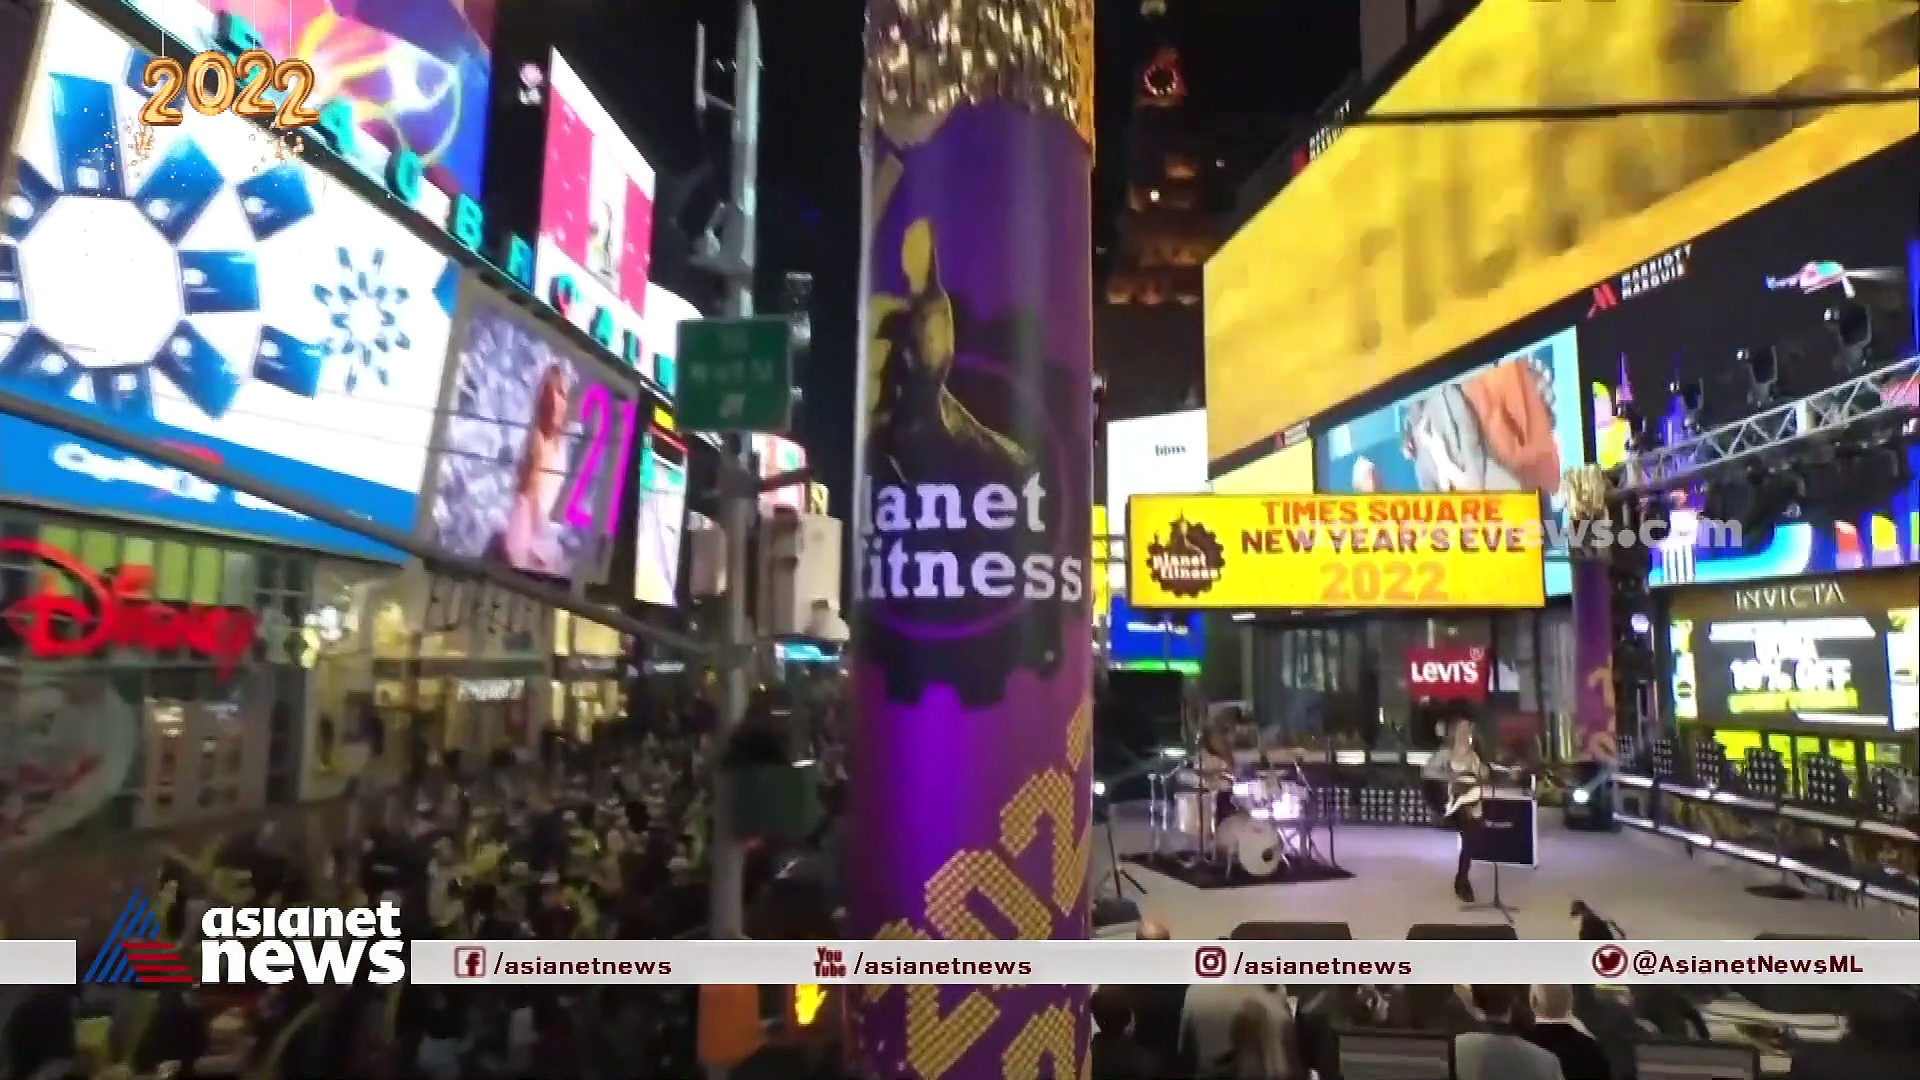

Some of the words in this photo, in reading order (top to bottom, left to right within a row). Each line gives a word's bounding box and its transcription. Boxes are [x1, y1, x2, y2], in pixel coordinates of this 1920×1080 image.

[1261, 500, 1359, 526] TIMES
[1368, 498, 1504, 526] SQUARE
[1241, 528, 1316, 555] NEW
[1326, 526, 1450, 554] YEAR'S
[1459, 526, 1526, 553] EVE
[1319, 560, 1450, 602] 2022
[1734, 581, 1847, 610] INVICTA
